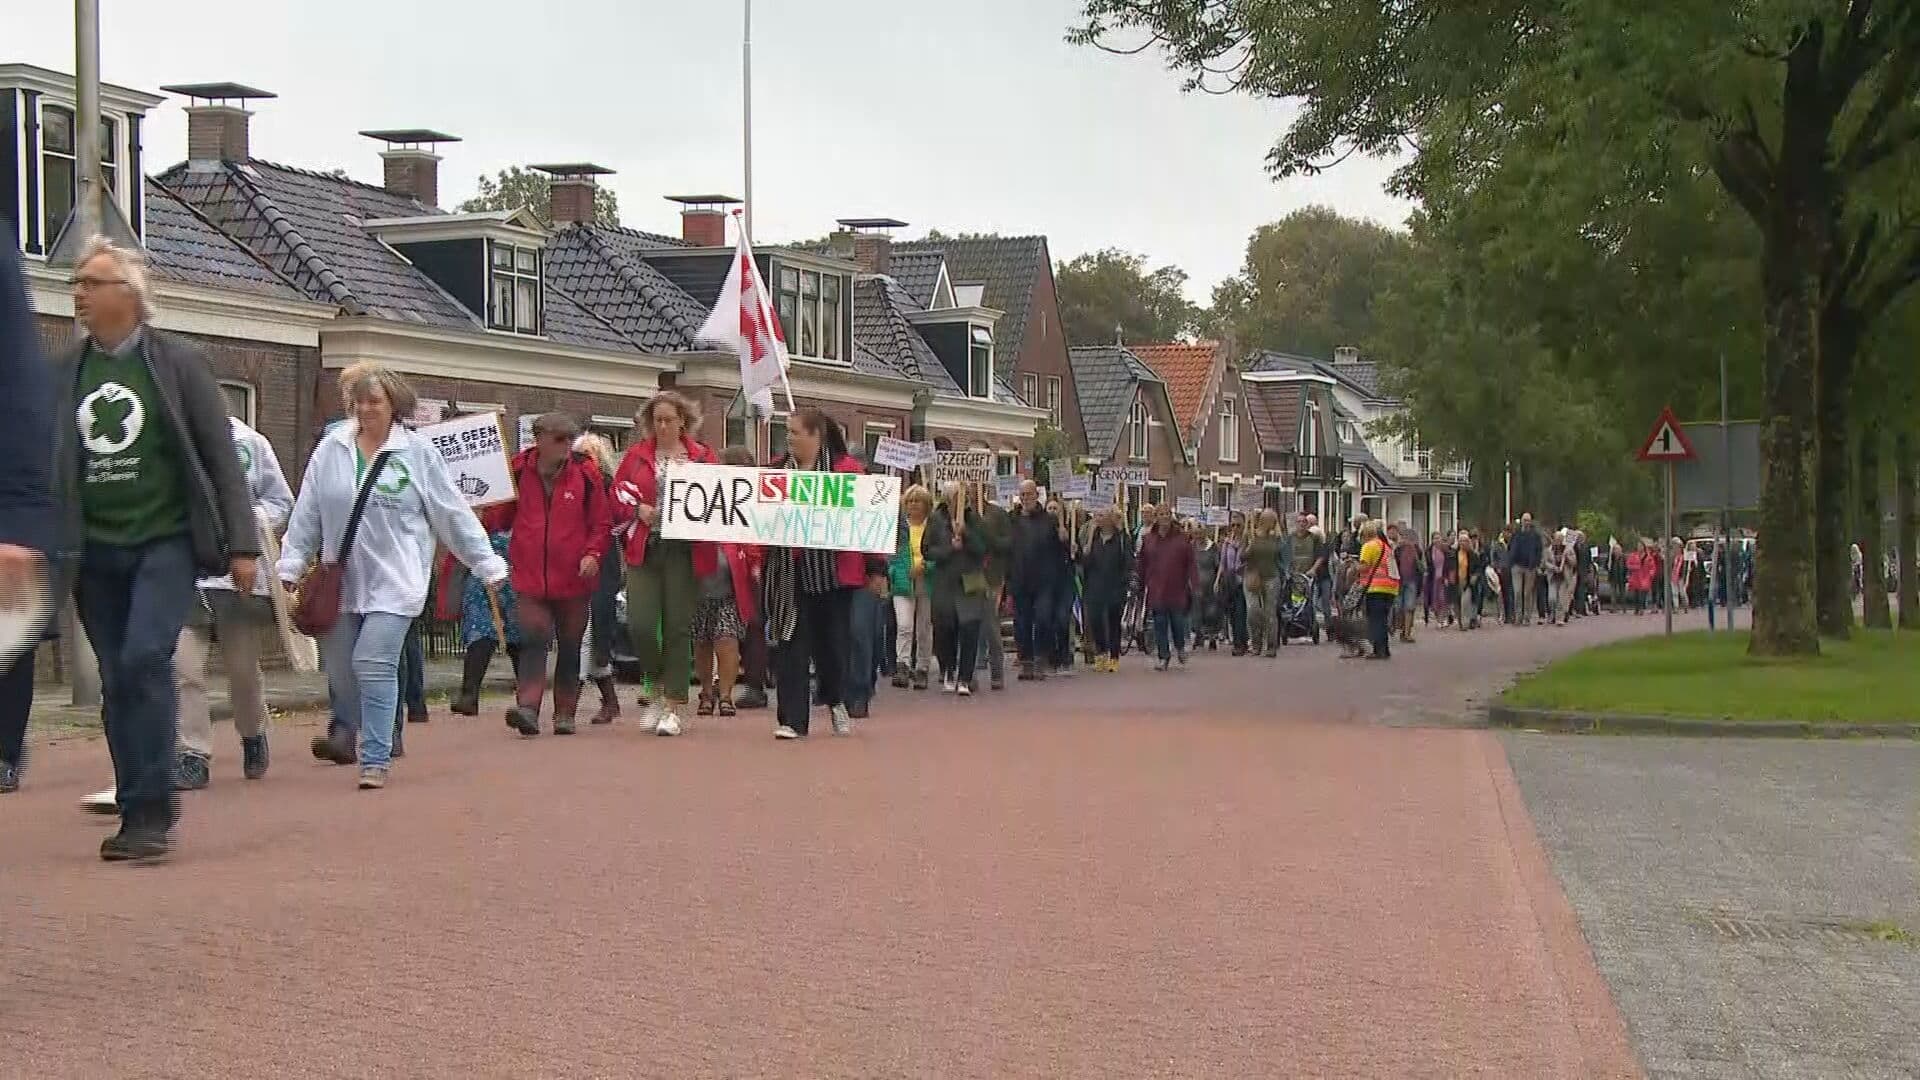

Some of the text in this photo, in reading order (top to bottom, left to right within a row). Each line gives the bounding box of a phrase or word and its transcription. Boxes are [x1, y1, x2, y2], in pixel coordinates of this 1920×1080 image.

[461, 426, 498, 442] GEEN
[668, 479, 752, 527] FOAR
[870, 479, 893, 506] &
